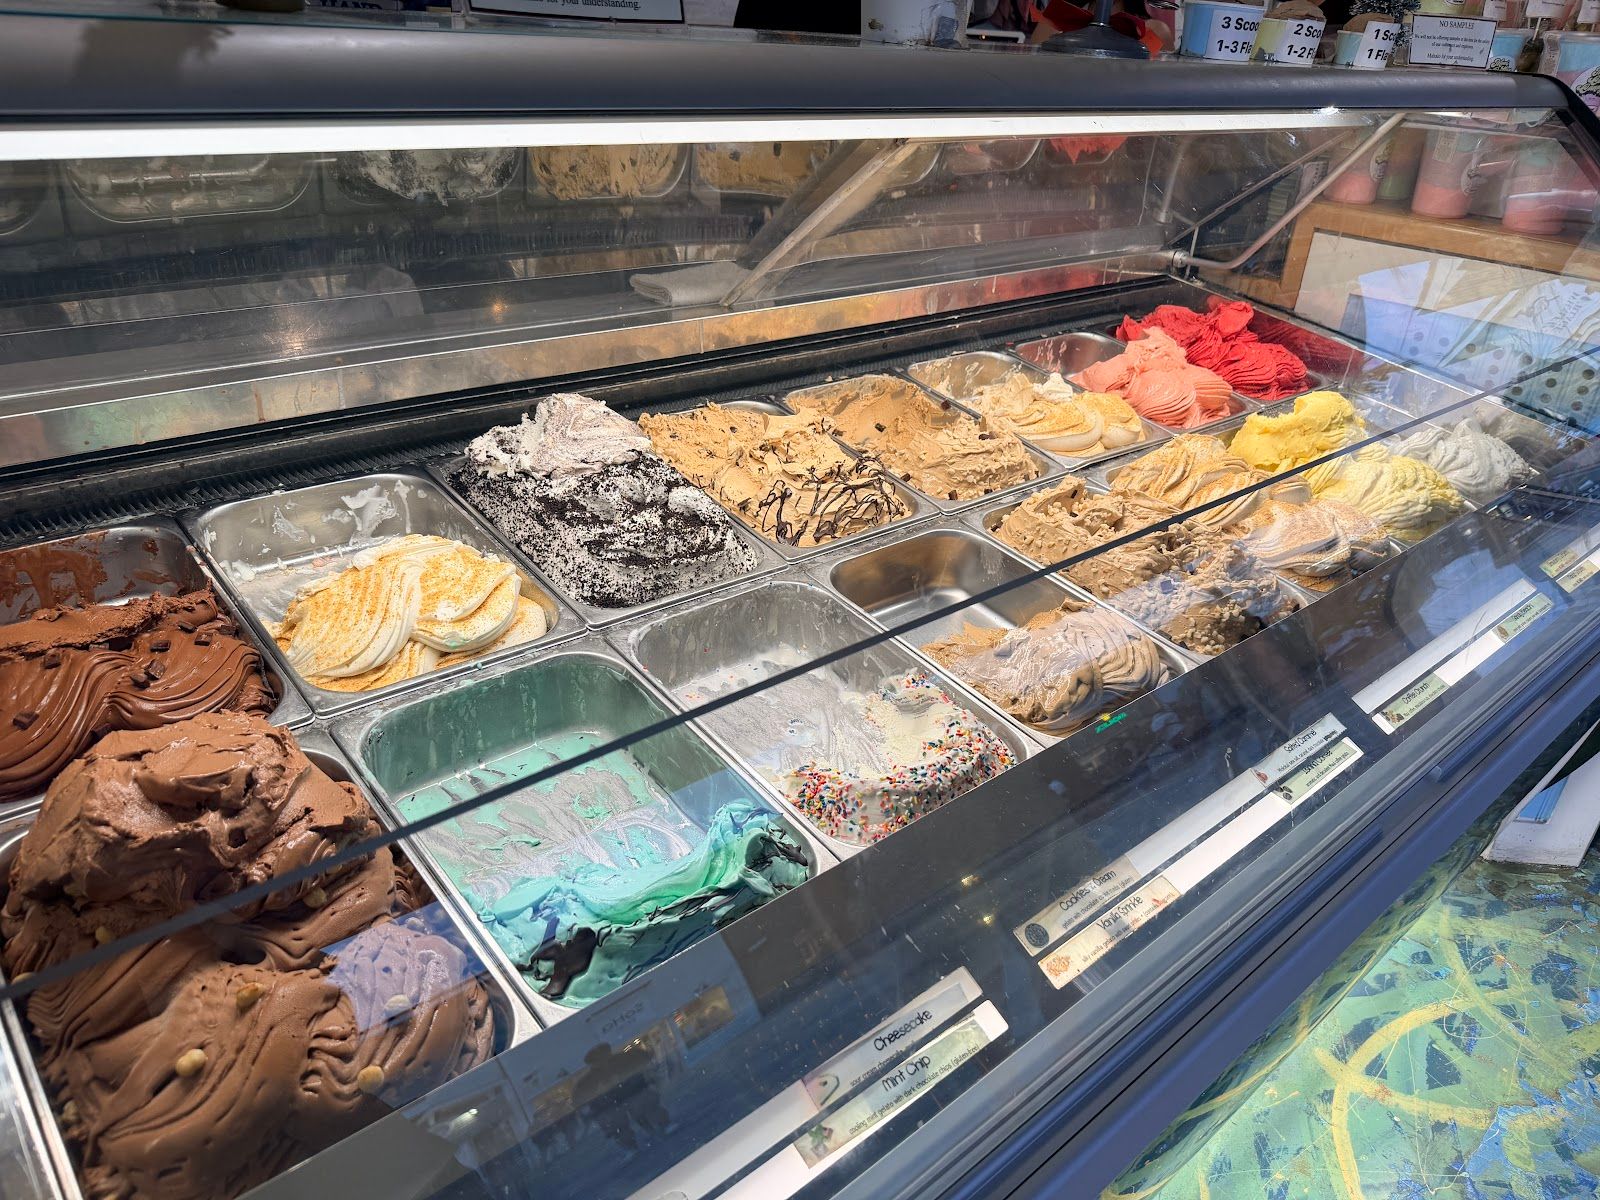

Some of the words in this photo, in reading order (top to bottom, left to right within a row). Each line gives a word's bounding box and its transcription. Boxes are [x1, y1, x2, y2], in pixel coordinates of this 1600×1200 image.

[1221, 16, 1231, 29] 3
[1293, 23, 1304, 35] 2
[1439, 20, 1449, 28] NO
[1374, 28, 1380, 39] 1
[1217, 39, 1239, 53] 1-3
[1287, 44, 1306, 58] 1-2
[1367, 48, 1374, 59] 1
[1059, 888, 1091, 911] Cookies
[1092, 870, 1117, 886] Cream
[1095, 911, 1121, 930] Vanilla
[1117, 896, 1143, 917] Sprinkle
[873, 1009, 933, 1051] Cheesecake
[881, 1070, 906, 1092] Mint
[905, 1055, 931, 1076] Chip
[849, 1119, 868, 1135] cooling
[866, 1111, 878, 1122] mint
[878, 1101, 894, 1117] gelato
[894, 1094, 904, 1104] with
[903, 1085, 915, 1097] dark
[915, 1071, 939, 1091] chocolate
[938, 1061, 953, 1077] chips
